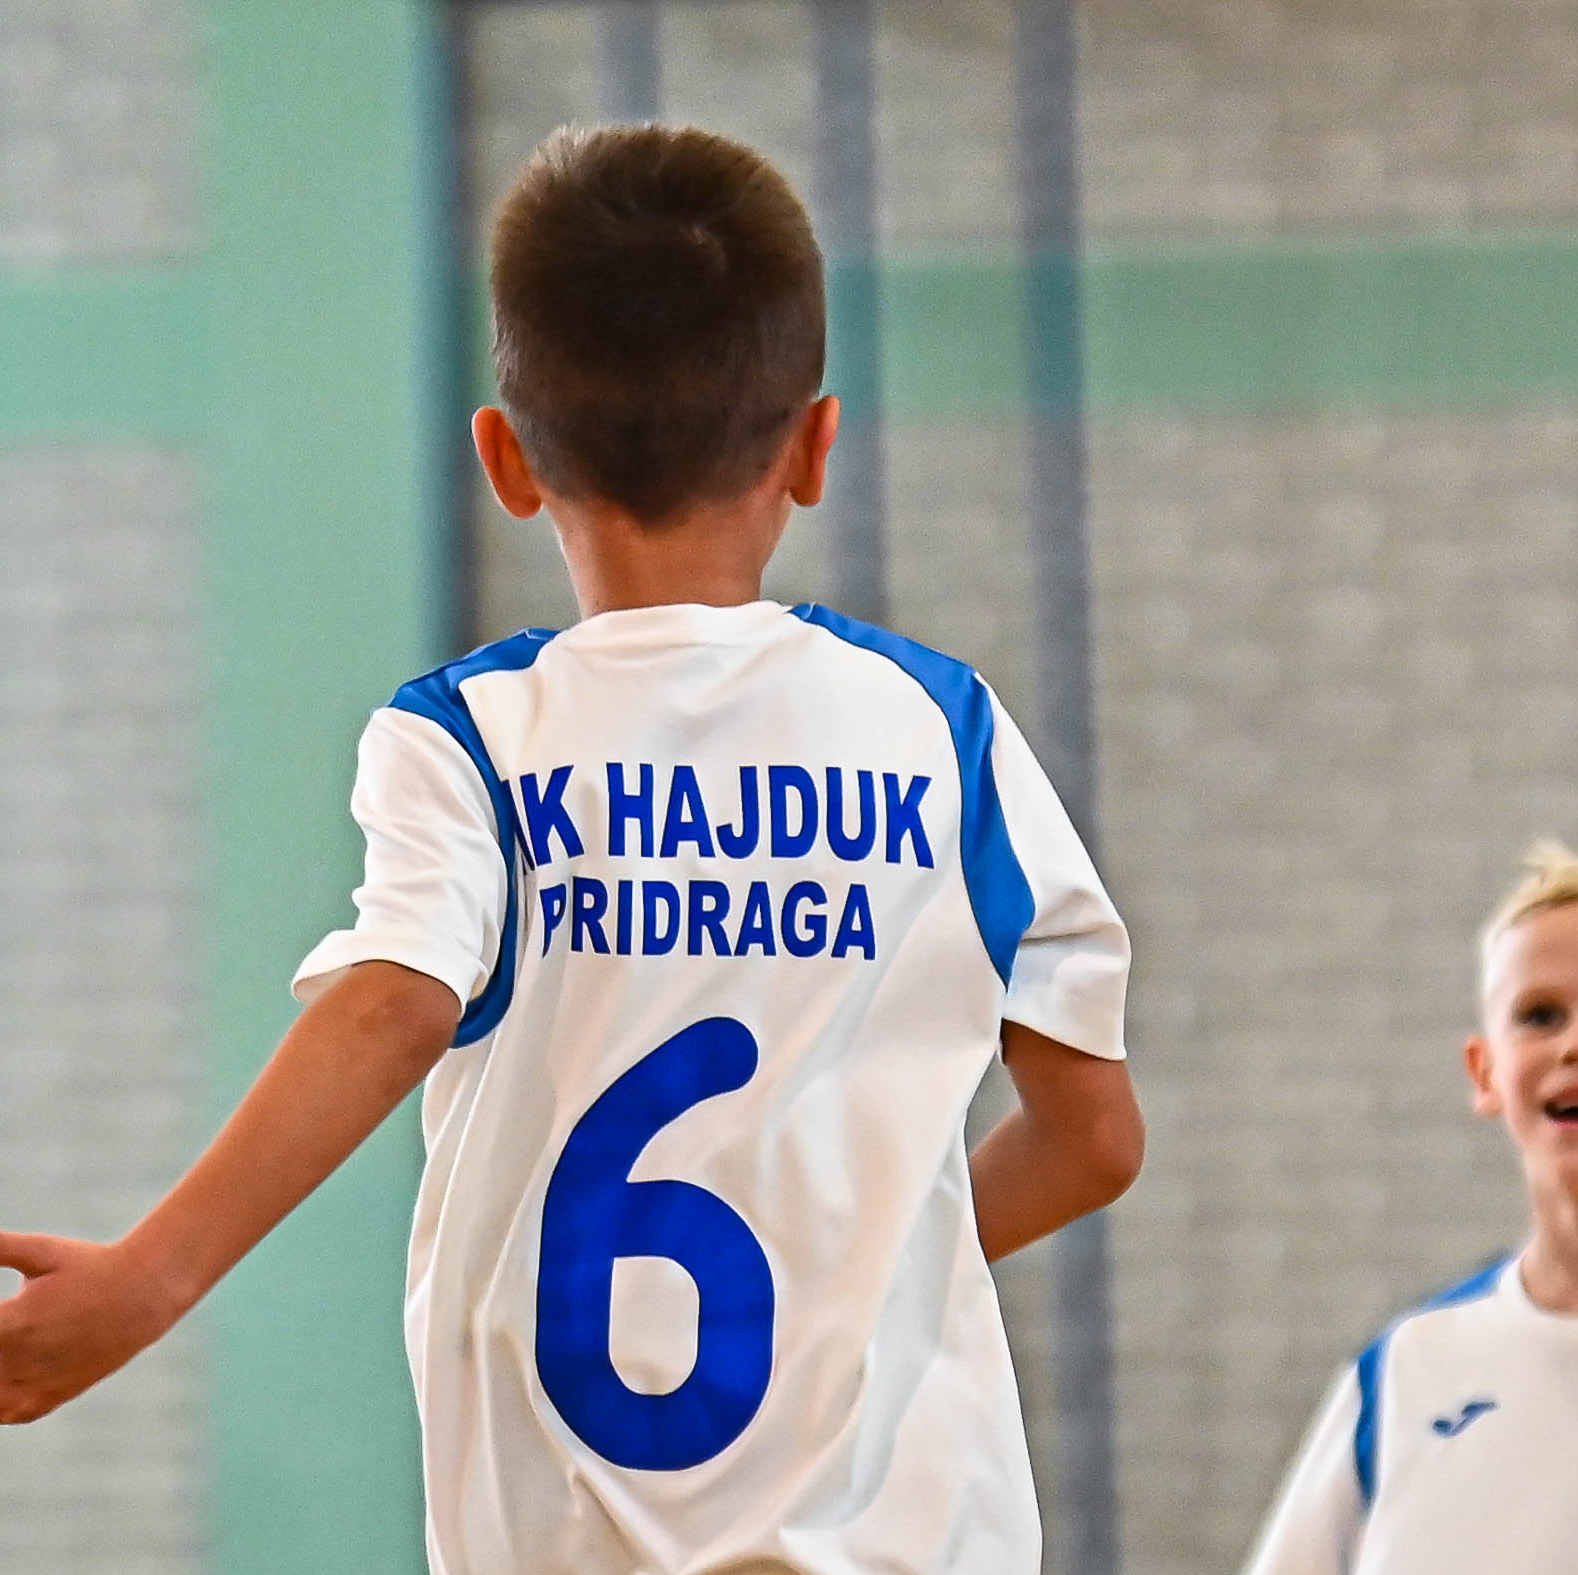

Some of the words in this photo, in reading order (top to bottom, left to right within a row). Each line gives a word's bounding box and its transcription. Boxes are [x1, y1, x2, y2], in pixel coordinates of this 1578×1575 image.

[606, 761, 935, 869] HAJDUK
[539, 875, 877, 961] PRIDRAGA
[535, 1016, 776, 1472] 6
